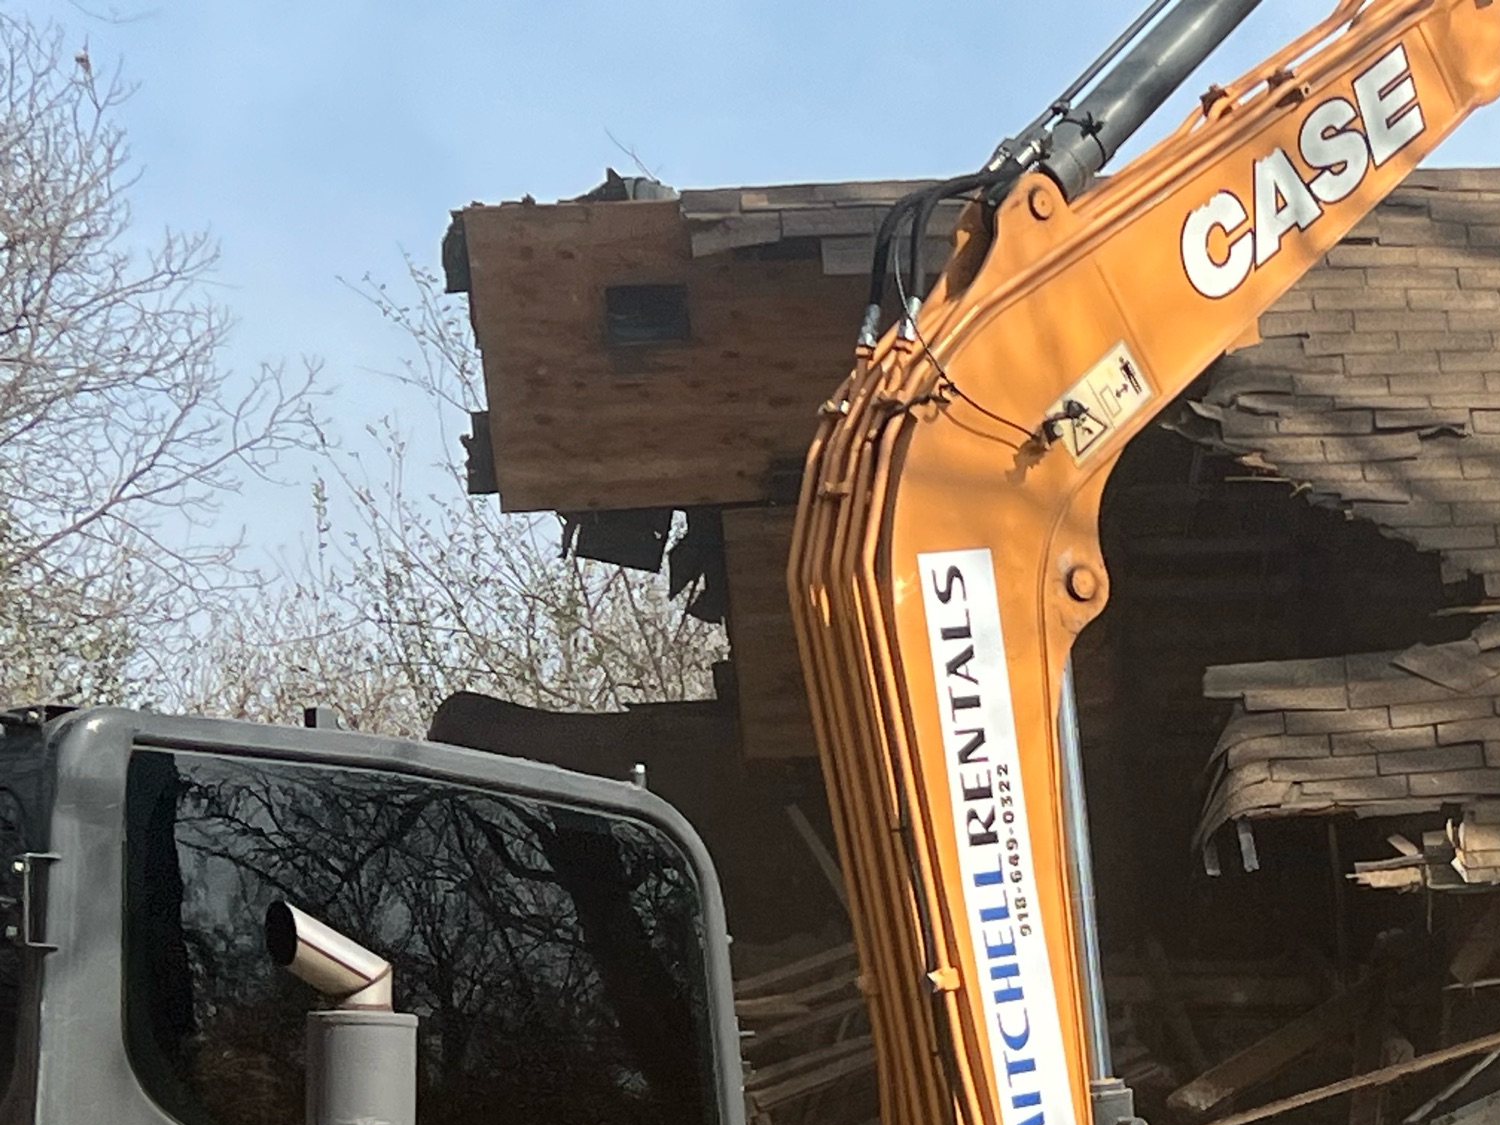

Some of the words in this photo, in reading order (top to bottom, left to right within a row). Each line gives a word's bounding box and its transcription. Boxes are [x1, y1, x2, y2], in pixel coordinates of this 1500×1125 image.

[1181, 42, 1426, 299] CASE
[932, 565, 999, 847] RENTALS
[997, 763, 1031, 937] 918-649-0322
